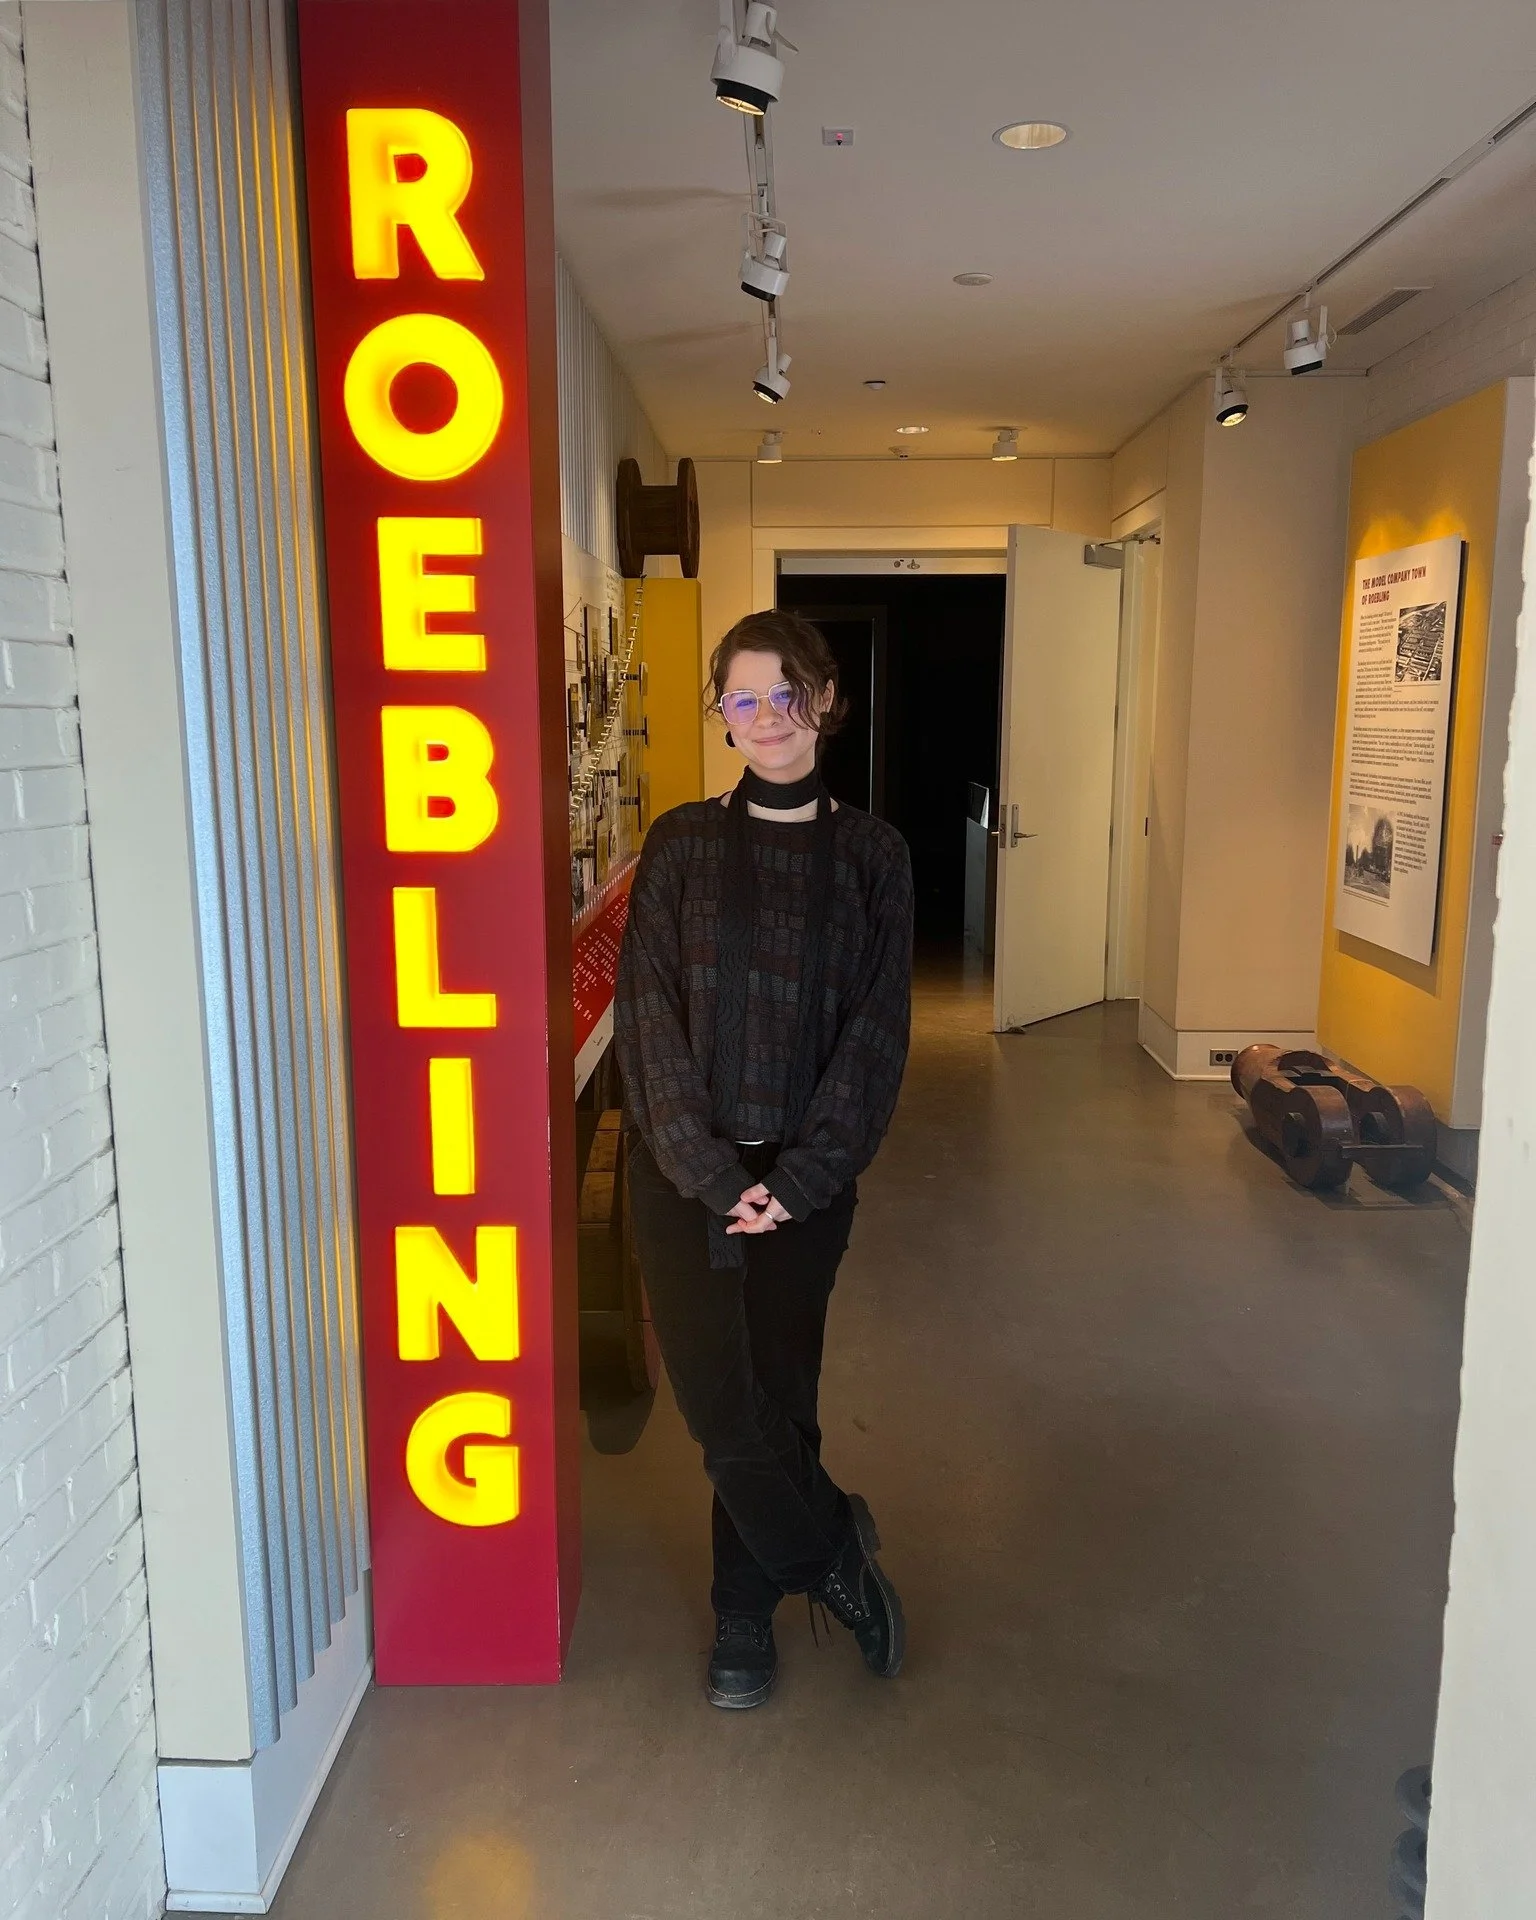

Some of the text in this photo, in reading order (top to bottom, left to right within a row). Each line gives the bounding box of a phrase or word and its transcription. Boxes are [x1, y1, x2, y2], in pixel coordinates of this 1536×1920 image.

[1362, 566, 1427, 590] THE MODEL COMPANY TOWN
[1361, 590, 1390, 605] OF ROEBLING
[344, 107, 520, 1528] ROEBLING
